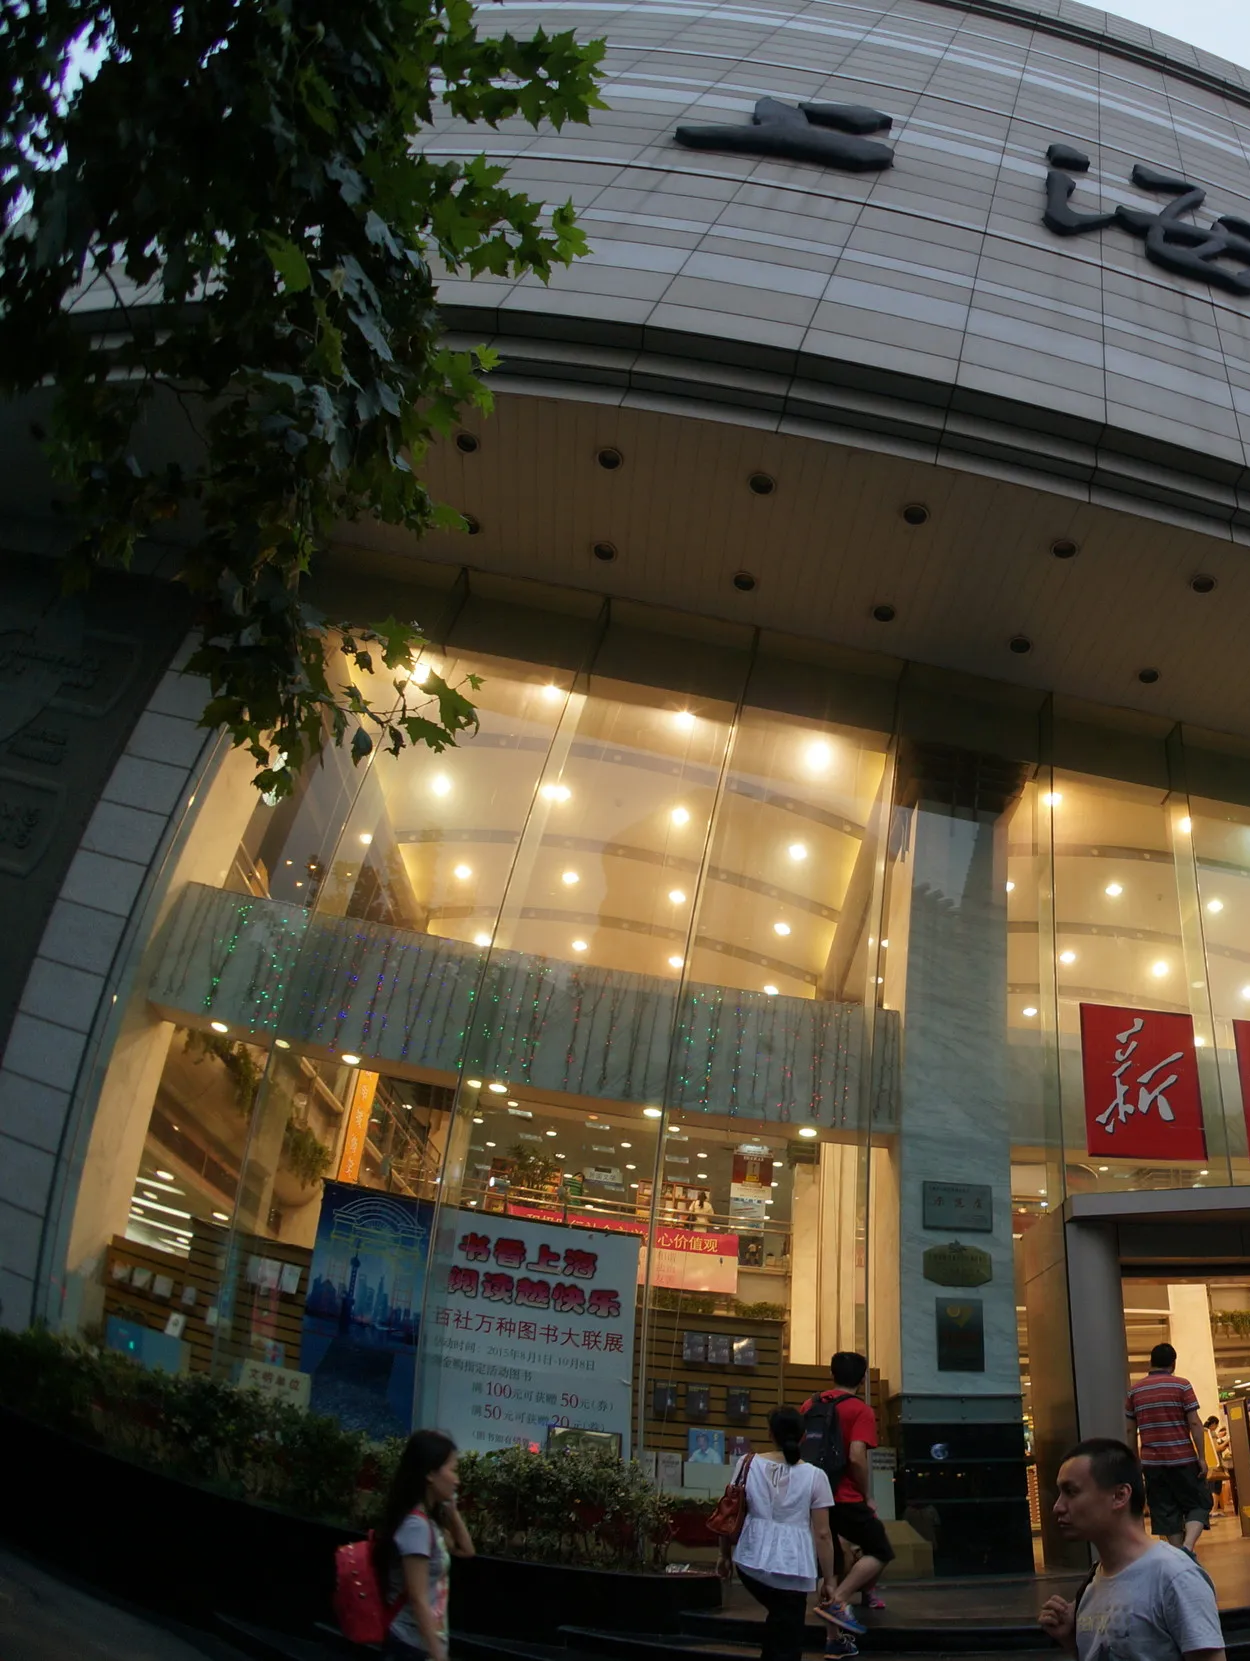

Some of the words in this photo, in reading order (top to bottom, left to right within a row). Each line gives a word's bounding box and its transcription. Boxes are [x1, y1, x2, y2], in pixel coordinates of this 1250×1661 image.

[458, 1232, 597, 1280] 书香上海
[657, 1232, 719, 1253] 心价值观
[448, 1265, 621, 1319] 阅读越快乐
[436, 1307, 625, 1354] 百社万种图书大联展
[250, 1368, 301, 1392] 文明单位
